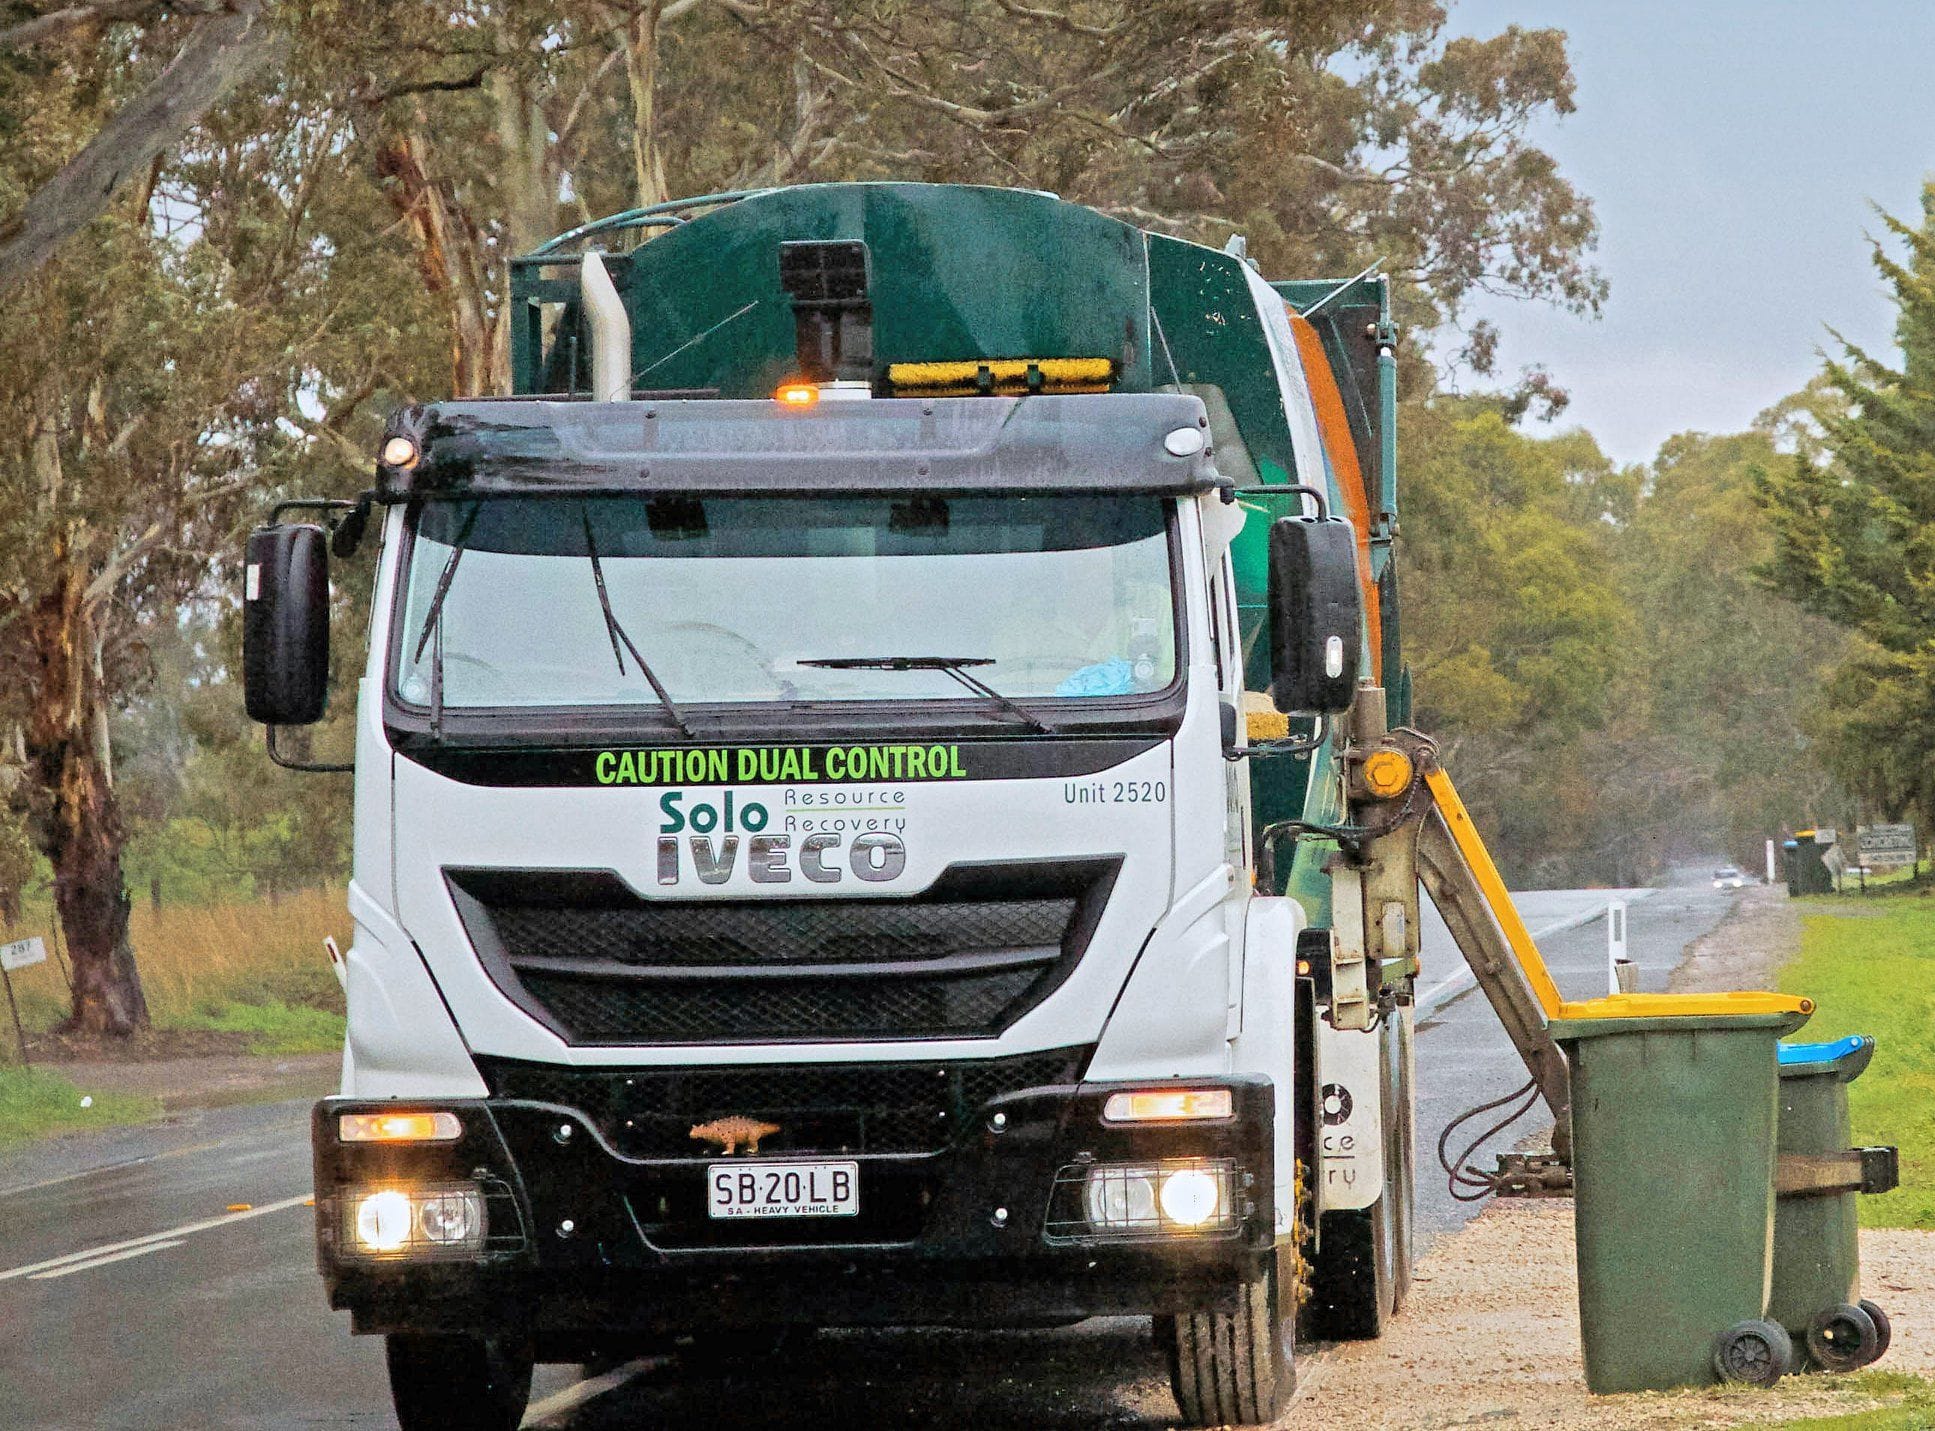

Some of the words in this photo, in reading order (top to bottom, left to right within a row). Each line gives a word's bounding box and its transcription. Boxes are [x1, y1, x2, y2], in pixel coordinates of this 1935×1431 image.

[596, 750, 728, 784] CAUTION
[738, 748, 818, 781] DUAL
[826, 745, 967, 779] CONTROL
[785, 788, 905, 805] Resource
[1064, 782, 1106, 804] Unit
[1113, 781, 1166, 803] 2520
[659, 790, 769, 834] Solo
[785, 815, 906, 834] Recovery
[657, 832, 906, 886] IVECO
[753, 1206, 789, 1215] HEAVY
[794, 1205, 839, 1214] VEHICLE
